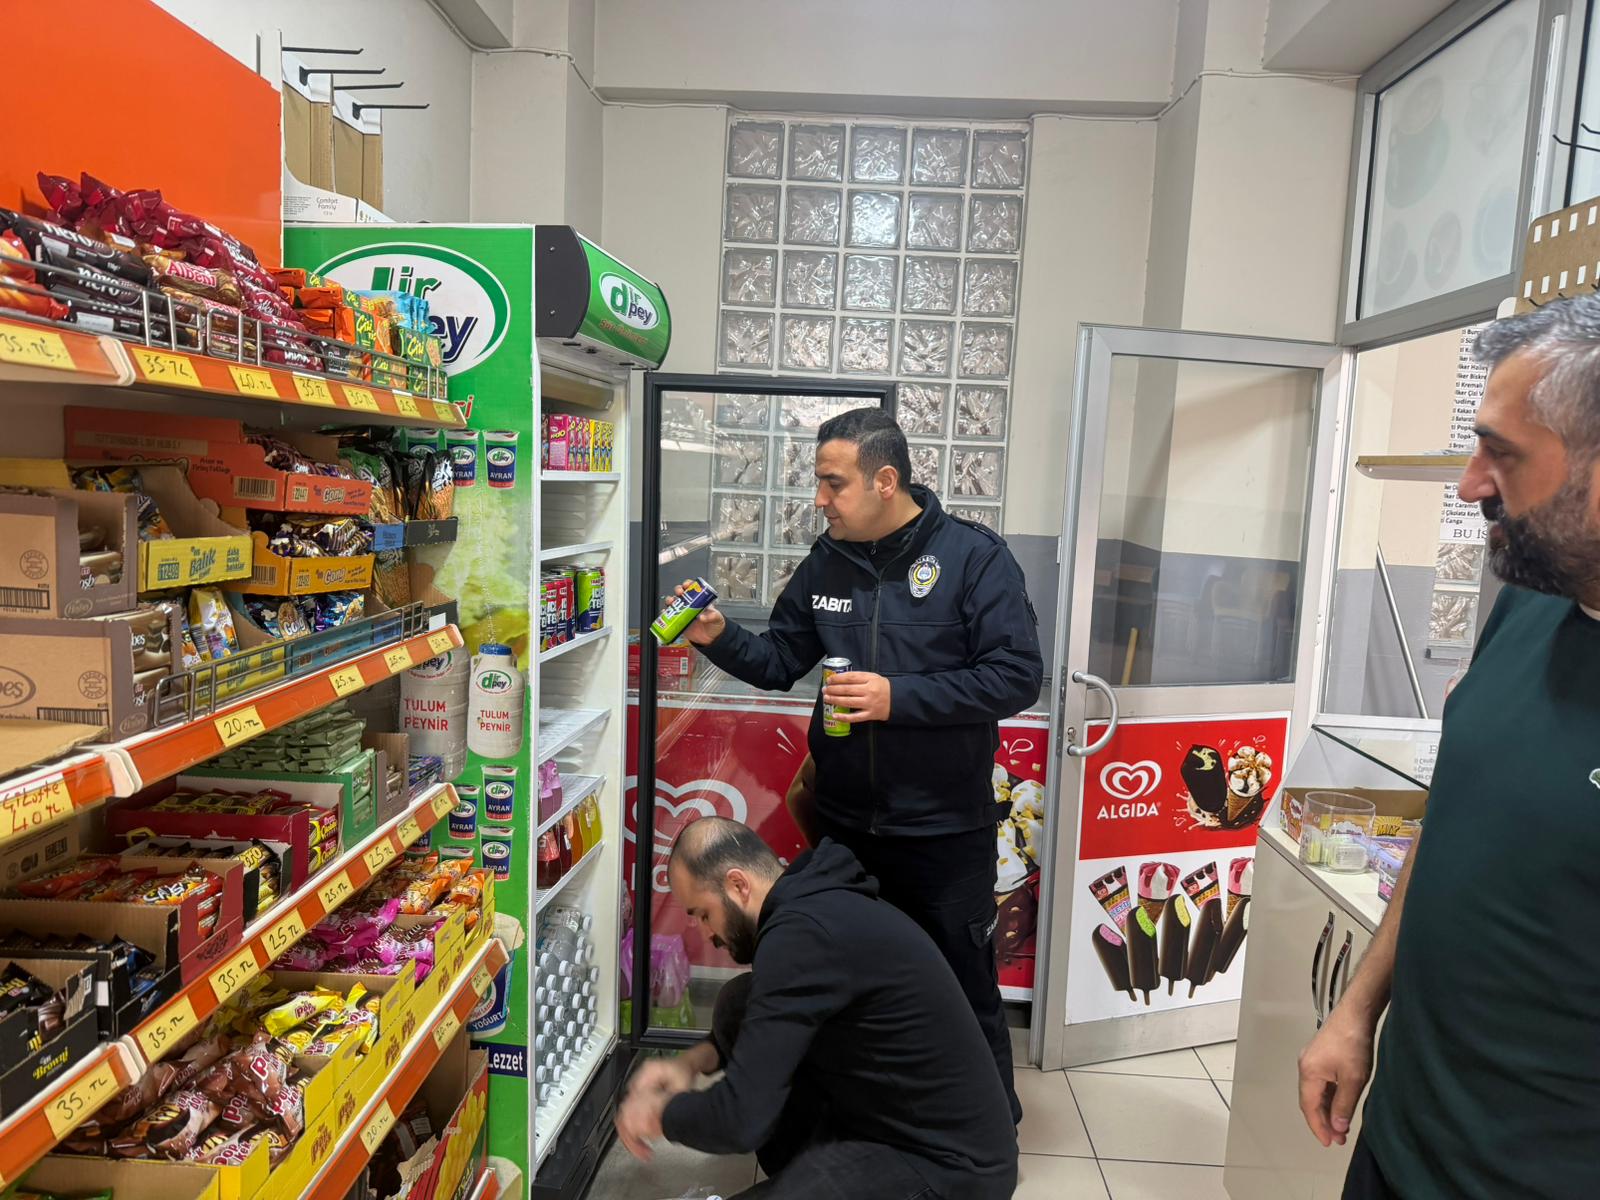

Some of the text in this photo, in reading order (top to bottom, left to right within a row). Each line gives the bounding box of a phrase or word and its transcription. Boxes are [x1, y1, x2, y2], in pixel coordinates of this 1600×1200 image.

[166, 258, 217, 288] Albeni
[1454, 398, 1475, 406] uding
[489, 471, 513, 479] AYRAN
[1452, 528, 1472, 539] BU
[404, 698, 447, 713] TULUM
[480, 709, 510, 720] TULUM
[404, 716, 449, 732] PEYNİR
[480, 722, 512, 733] PEYNİR
[487, 804, 511, 812] AYRAN
[1096, 802, 1159, 820] ALGIDA
[451, 823, 474, 831] AYRAN
[473, 1013, 504, 1030] YOĞURT
